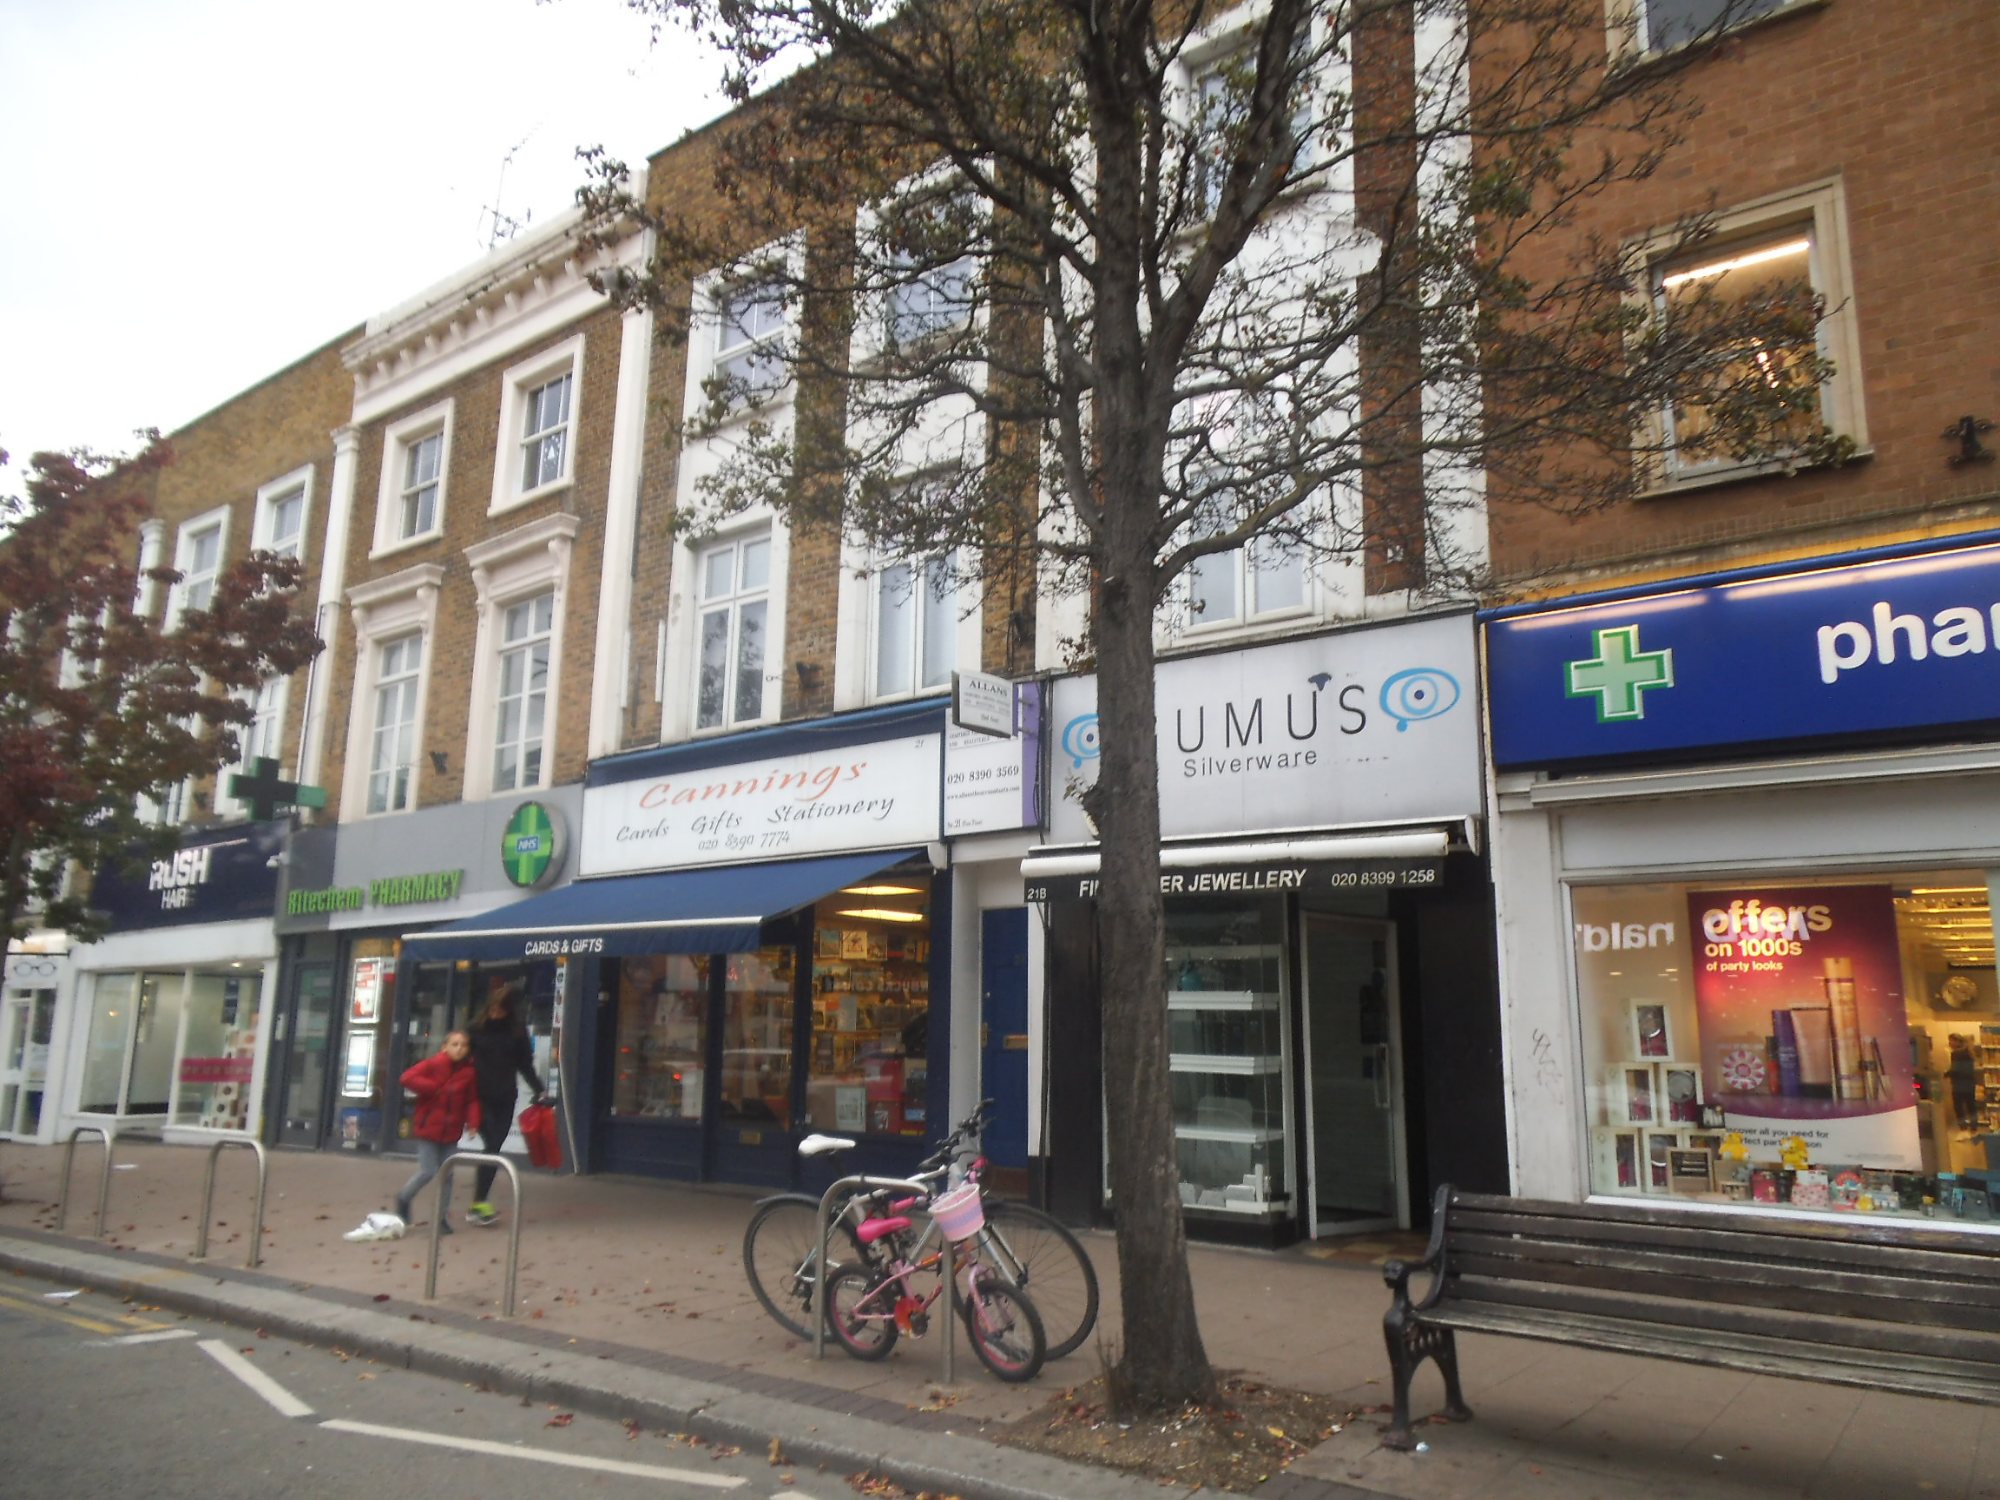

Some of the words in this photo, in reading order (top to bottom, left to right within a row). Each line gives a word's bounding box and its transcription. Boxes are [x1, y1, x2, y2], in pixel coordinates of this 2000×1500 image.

[969, 680, 1008, 697] ALLANS
[1183, 749, 1318, 778] Silverware
[638, 761, 869, 808] Cannings
[946, 772, 965, 785] 020
[968, 768, 992, 782] 8390
[616, 817, 670, 843] Cards
[690, 810, 743, 835] Gifts
[766, 797, 895, 825] Stationery
[517, 837, 538, 851] NHS
[149, 847, 211, 891] RUSH
[368, 869, 466, 907] PHARMACY
[1188, 869, 1308, 892] JEWELLERY
[1331, 873, 1358, 887] 020
[1360, 870, 1396, 886] 8399
[1399, 869, 1436, 884] 1258
[161, 887, 187, 909] HAIR
[1702, 899, 1833, 934] offers
[525, 940, 560, 955] CARDS
[560, 939, 569, 954] &
[571, 938, 603, 953] GIFTS
[1705, 943, 1733, 957] on
[1736, 938, 1803, 957] 1000s
[1706, 961, 1718, 973] of
[1720, 961, 1750, 973] party
[1752, 960, 1784, 972] looks
